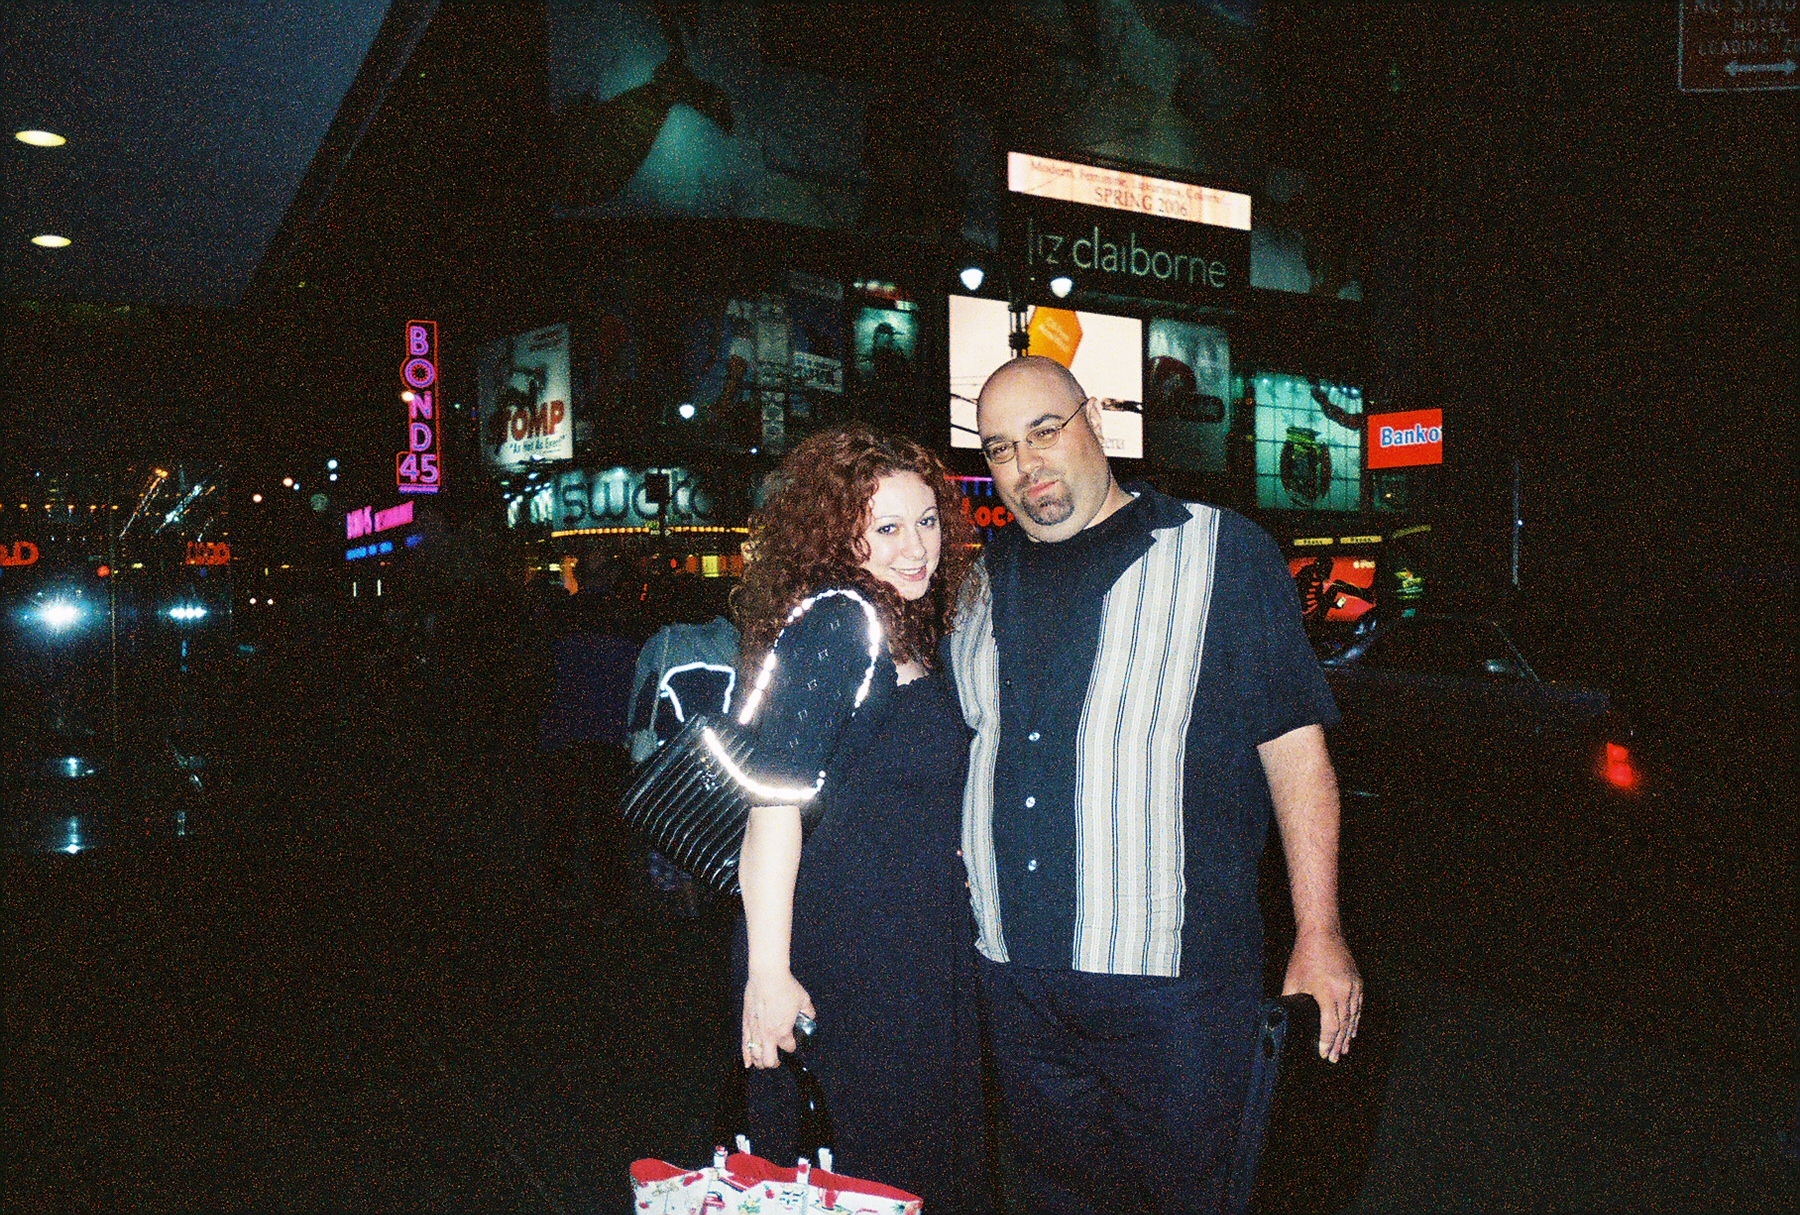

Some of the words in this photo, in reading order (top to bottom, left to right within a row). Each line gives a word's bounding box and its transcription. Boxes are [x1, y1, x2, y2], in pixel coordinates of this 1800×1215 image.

[1094, 187, 1153, 211] SPRING
[1072, 226, 1228, 289] claiborne
[405, 326, 436, 451] BOND
[400, 453, 438, 483] 45
